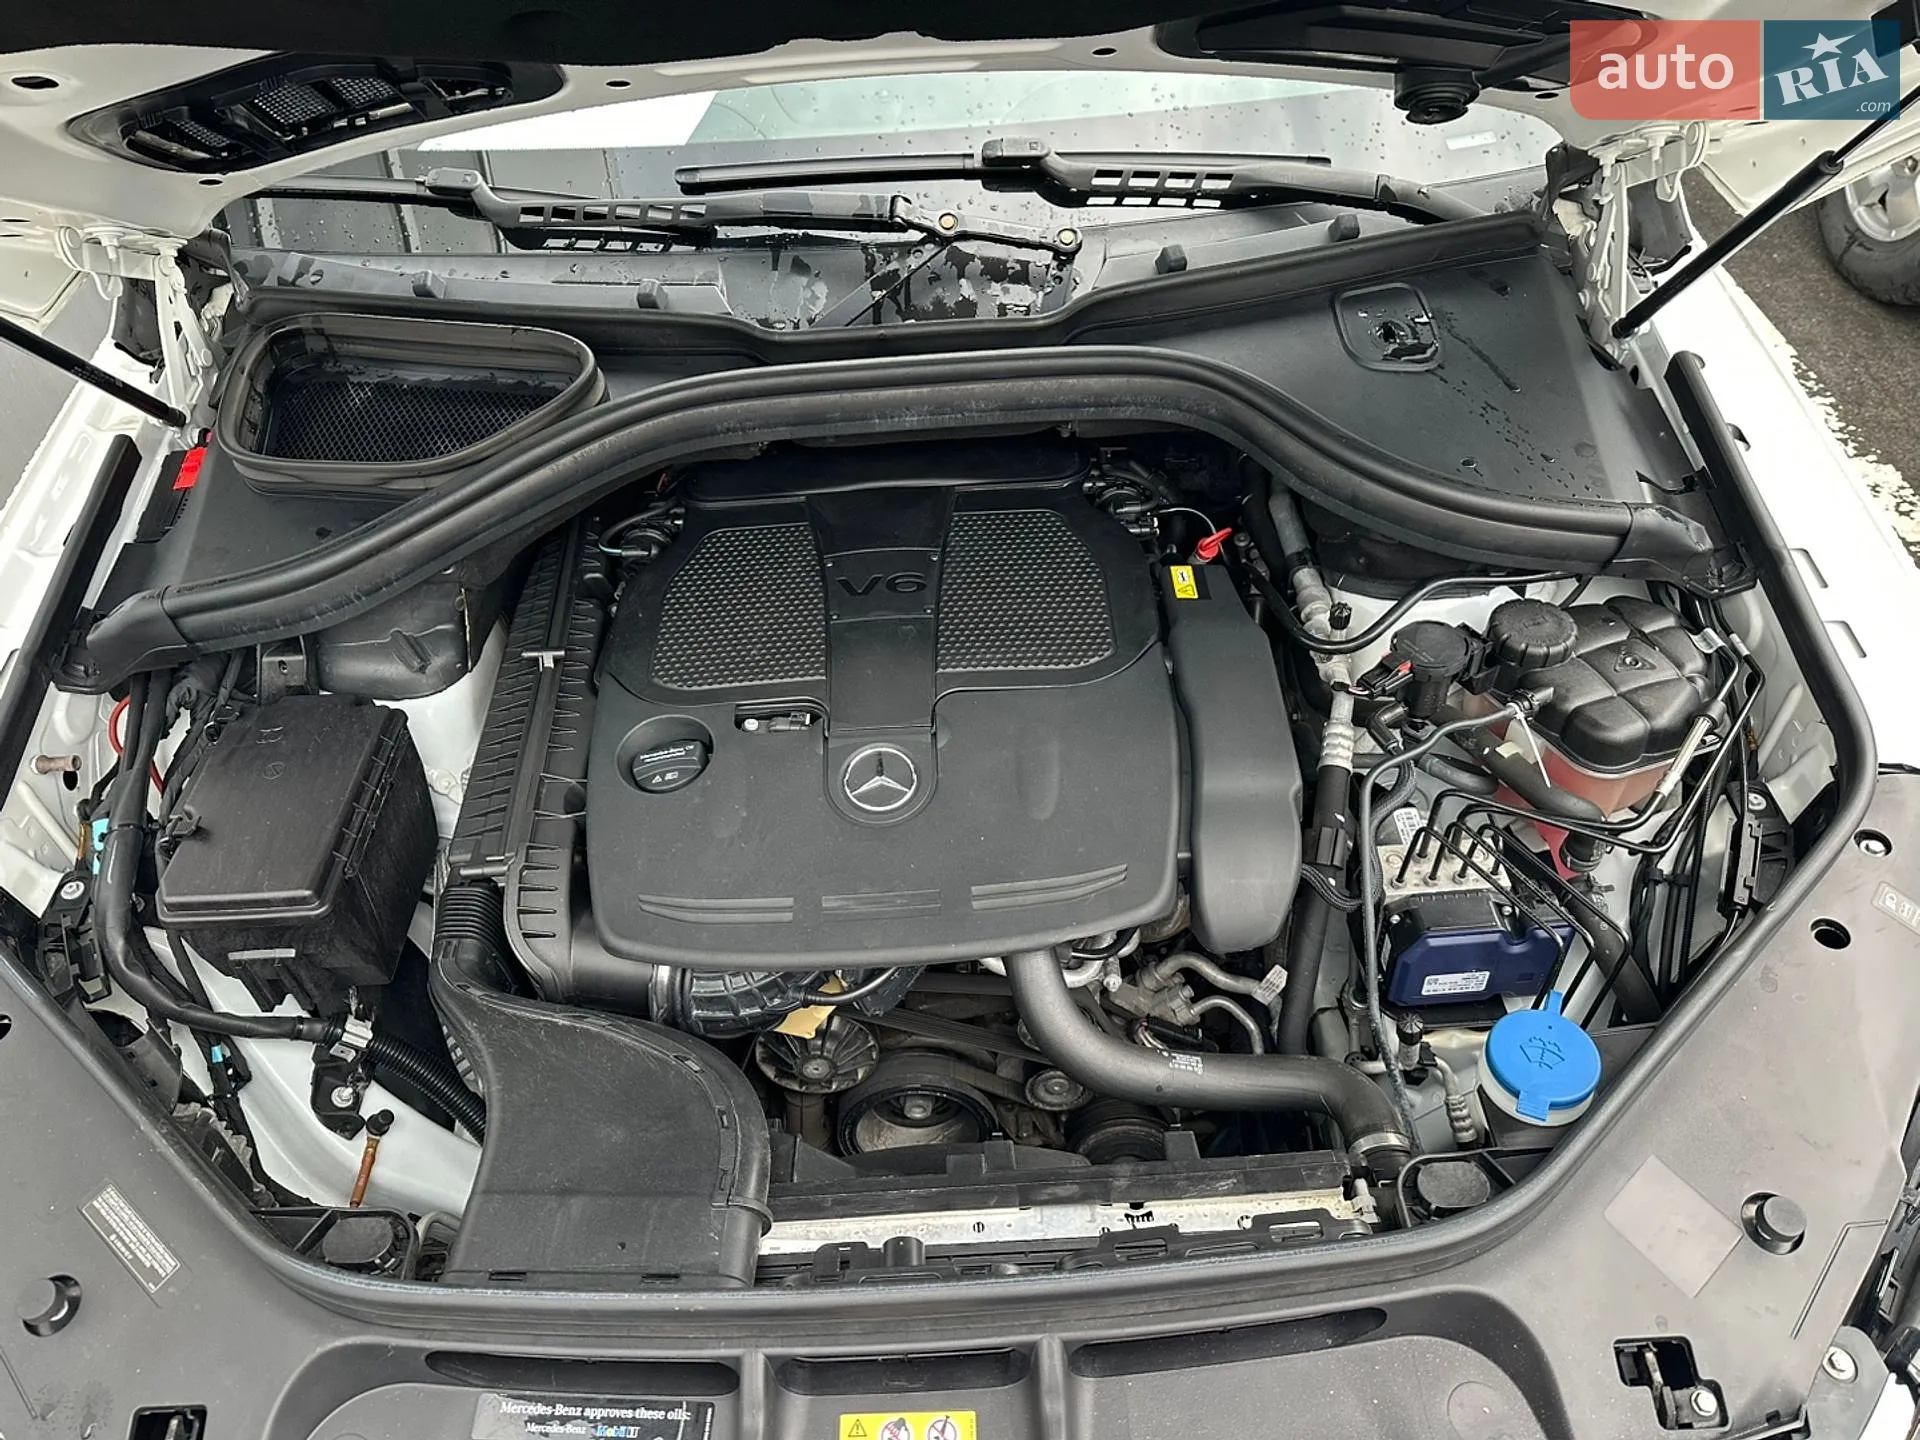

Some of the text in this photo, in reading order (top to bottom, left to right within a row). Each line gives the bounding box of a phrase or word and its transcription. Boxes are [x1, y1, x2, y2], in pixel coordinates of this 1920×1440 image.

[836, 571, 927, 597] V6
[499, 1401, 582, 1416] Mercedes-Benz
[583, 1407, 634, 1420] approves
[635, 1407, 665, 1420] these
[526, 1422, 587, 1434] Mercedes-Benz
